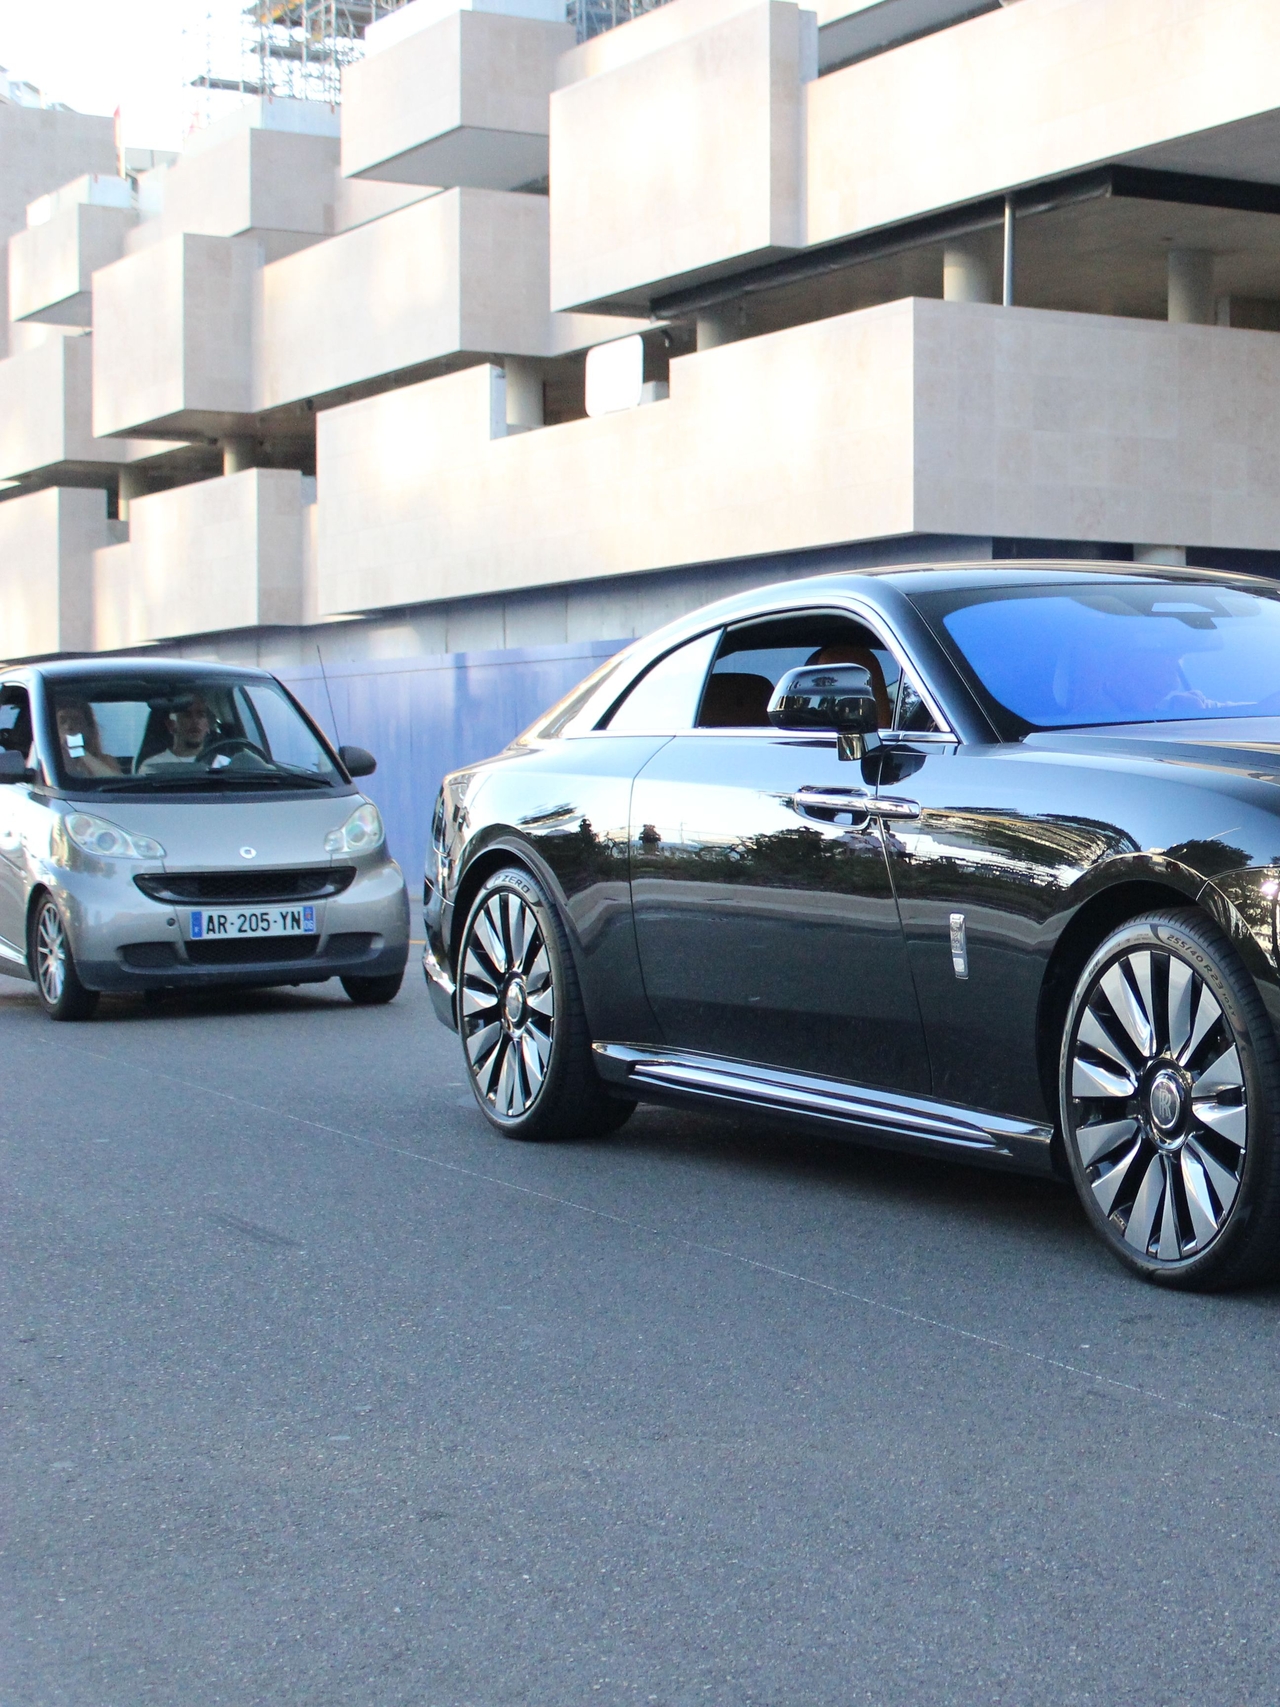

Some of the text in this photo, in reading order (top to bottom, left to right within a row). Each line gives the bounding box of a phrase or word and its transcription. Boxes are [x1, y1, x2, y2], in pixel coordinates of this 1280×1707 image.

[501, 874, 530, 894] ZERO
[206, 911, 301, 935] AR-205-YN
[1166, 934, 1204, 963] 255/40
[1203, 964, 1224, 990] R23
